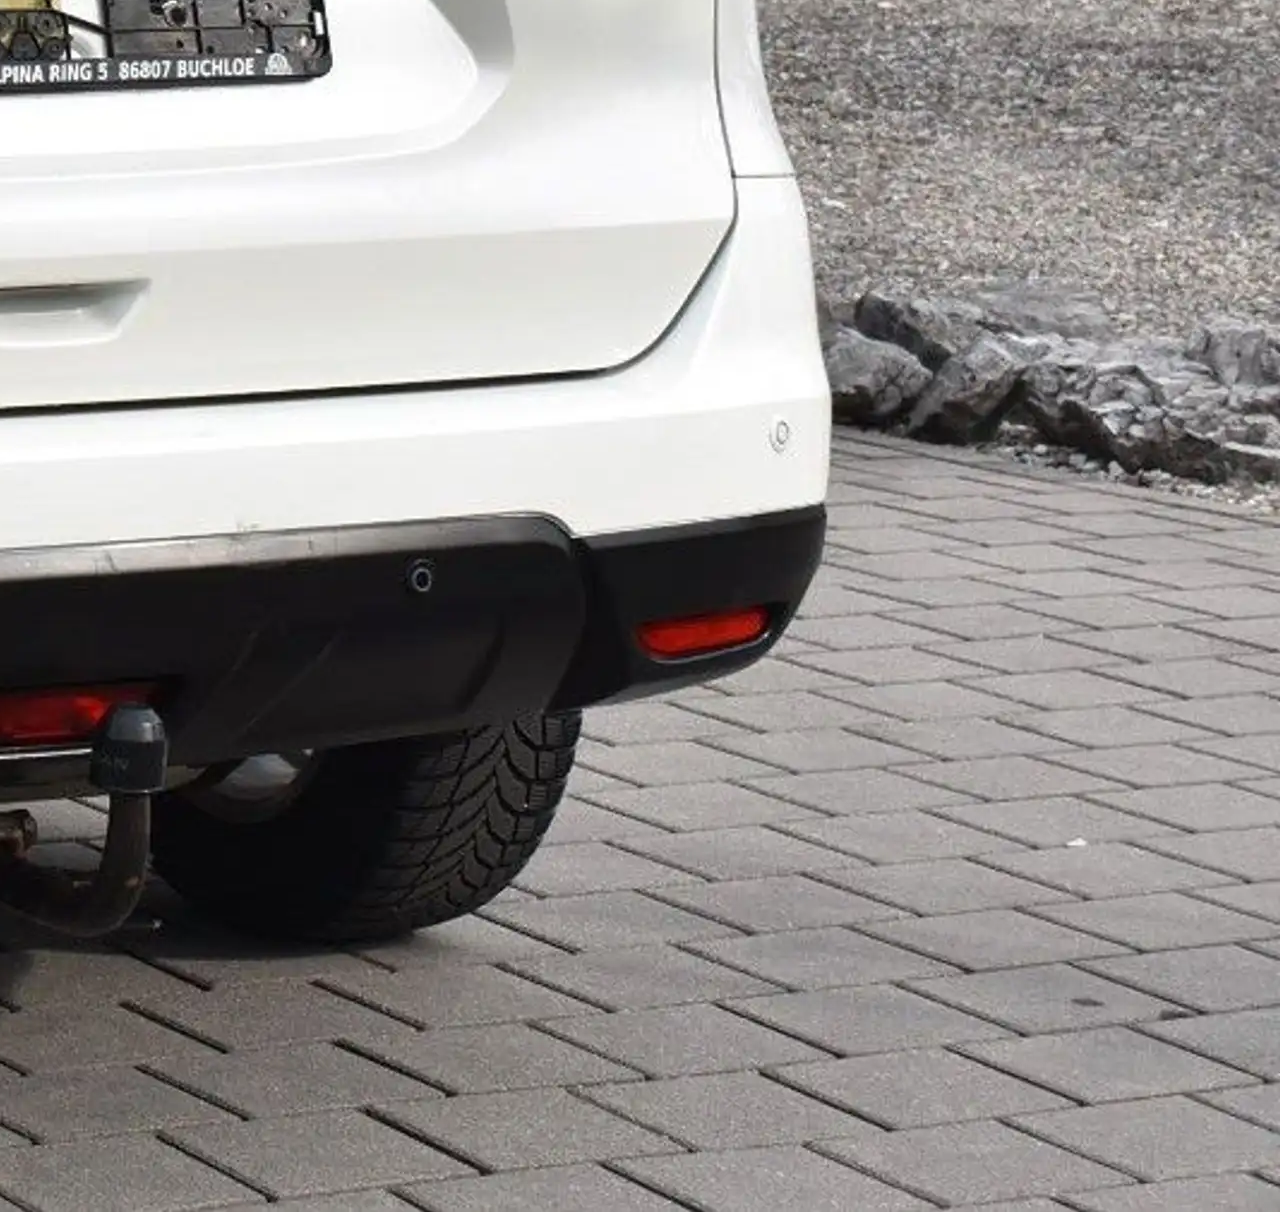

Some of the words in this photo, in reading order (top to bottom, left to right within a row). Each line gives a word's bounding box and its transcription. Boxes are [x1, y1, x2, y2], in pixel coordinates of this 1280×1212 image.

[49, 62, 91, 82] RING
[97, 61, 108, 81] 5
[118, 59, 172, 80] 86807
[176, 57, 255, 78] BUCHLOE
